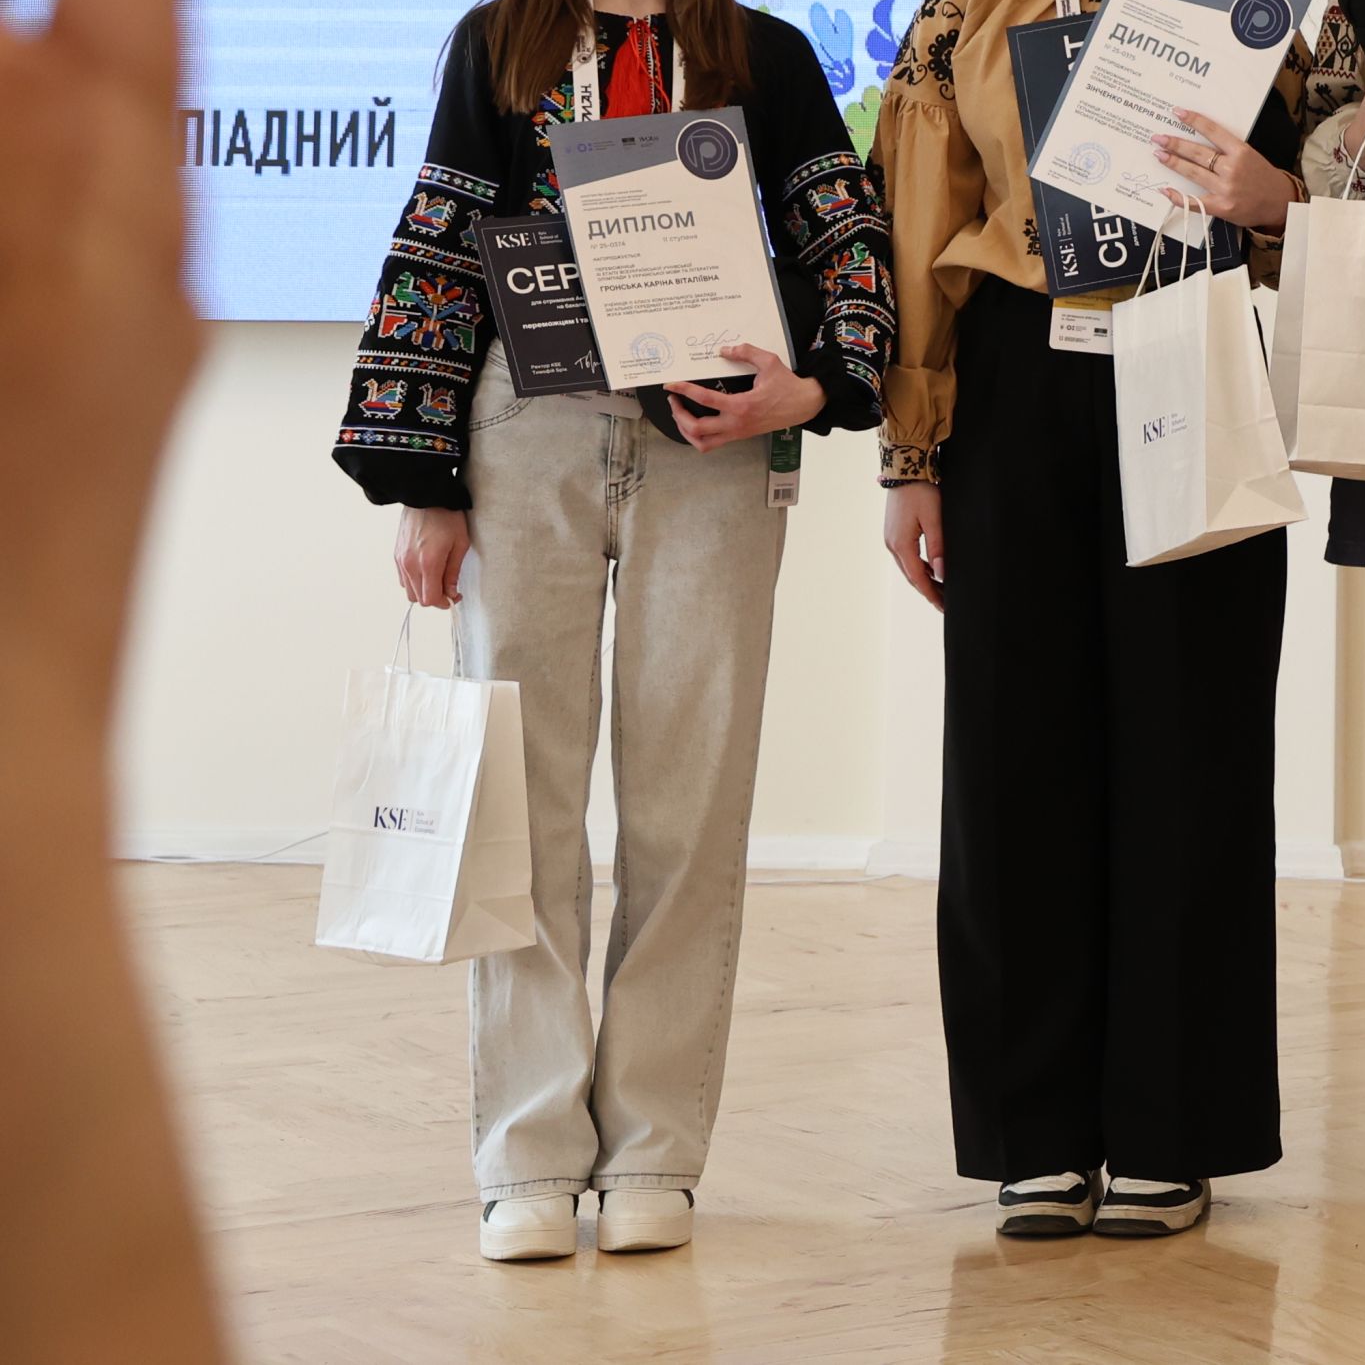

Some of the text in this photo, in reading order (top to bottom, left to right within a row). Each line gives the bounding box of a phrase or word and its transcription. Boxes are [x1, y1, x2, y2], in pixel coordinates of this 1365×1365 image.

[1108, 23, 1209, 76] ДИПЛОМ
[1086, 83, 1122, 103] ЗІНЧЕНКО
[1123, 99, 1154, 117] ВАЛЕРІЯ
[588, 211, 694, 239] ДИПЛОМ
[495, 232, 531, 248] KSE
[1059, 243, 1078, 276] KSE
[643, 279, 673, 287] КАРІНА
[675, 274, 719, 284] ВІТАЛІЇВНА
[1144, 416, 1166, 444] KSE
[374, 806, 408, 831] KSE
